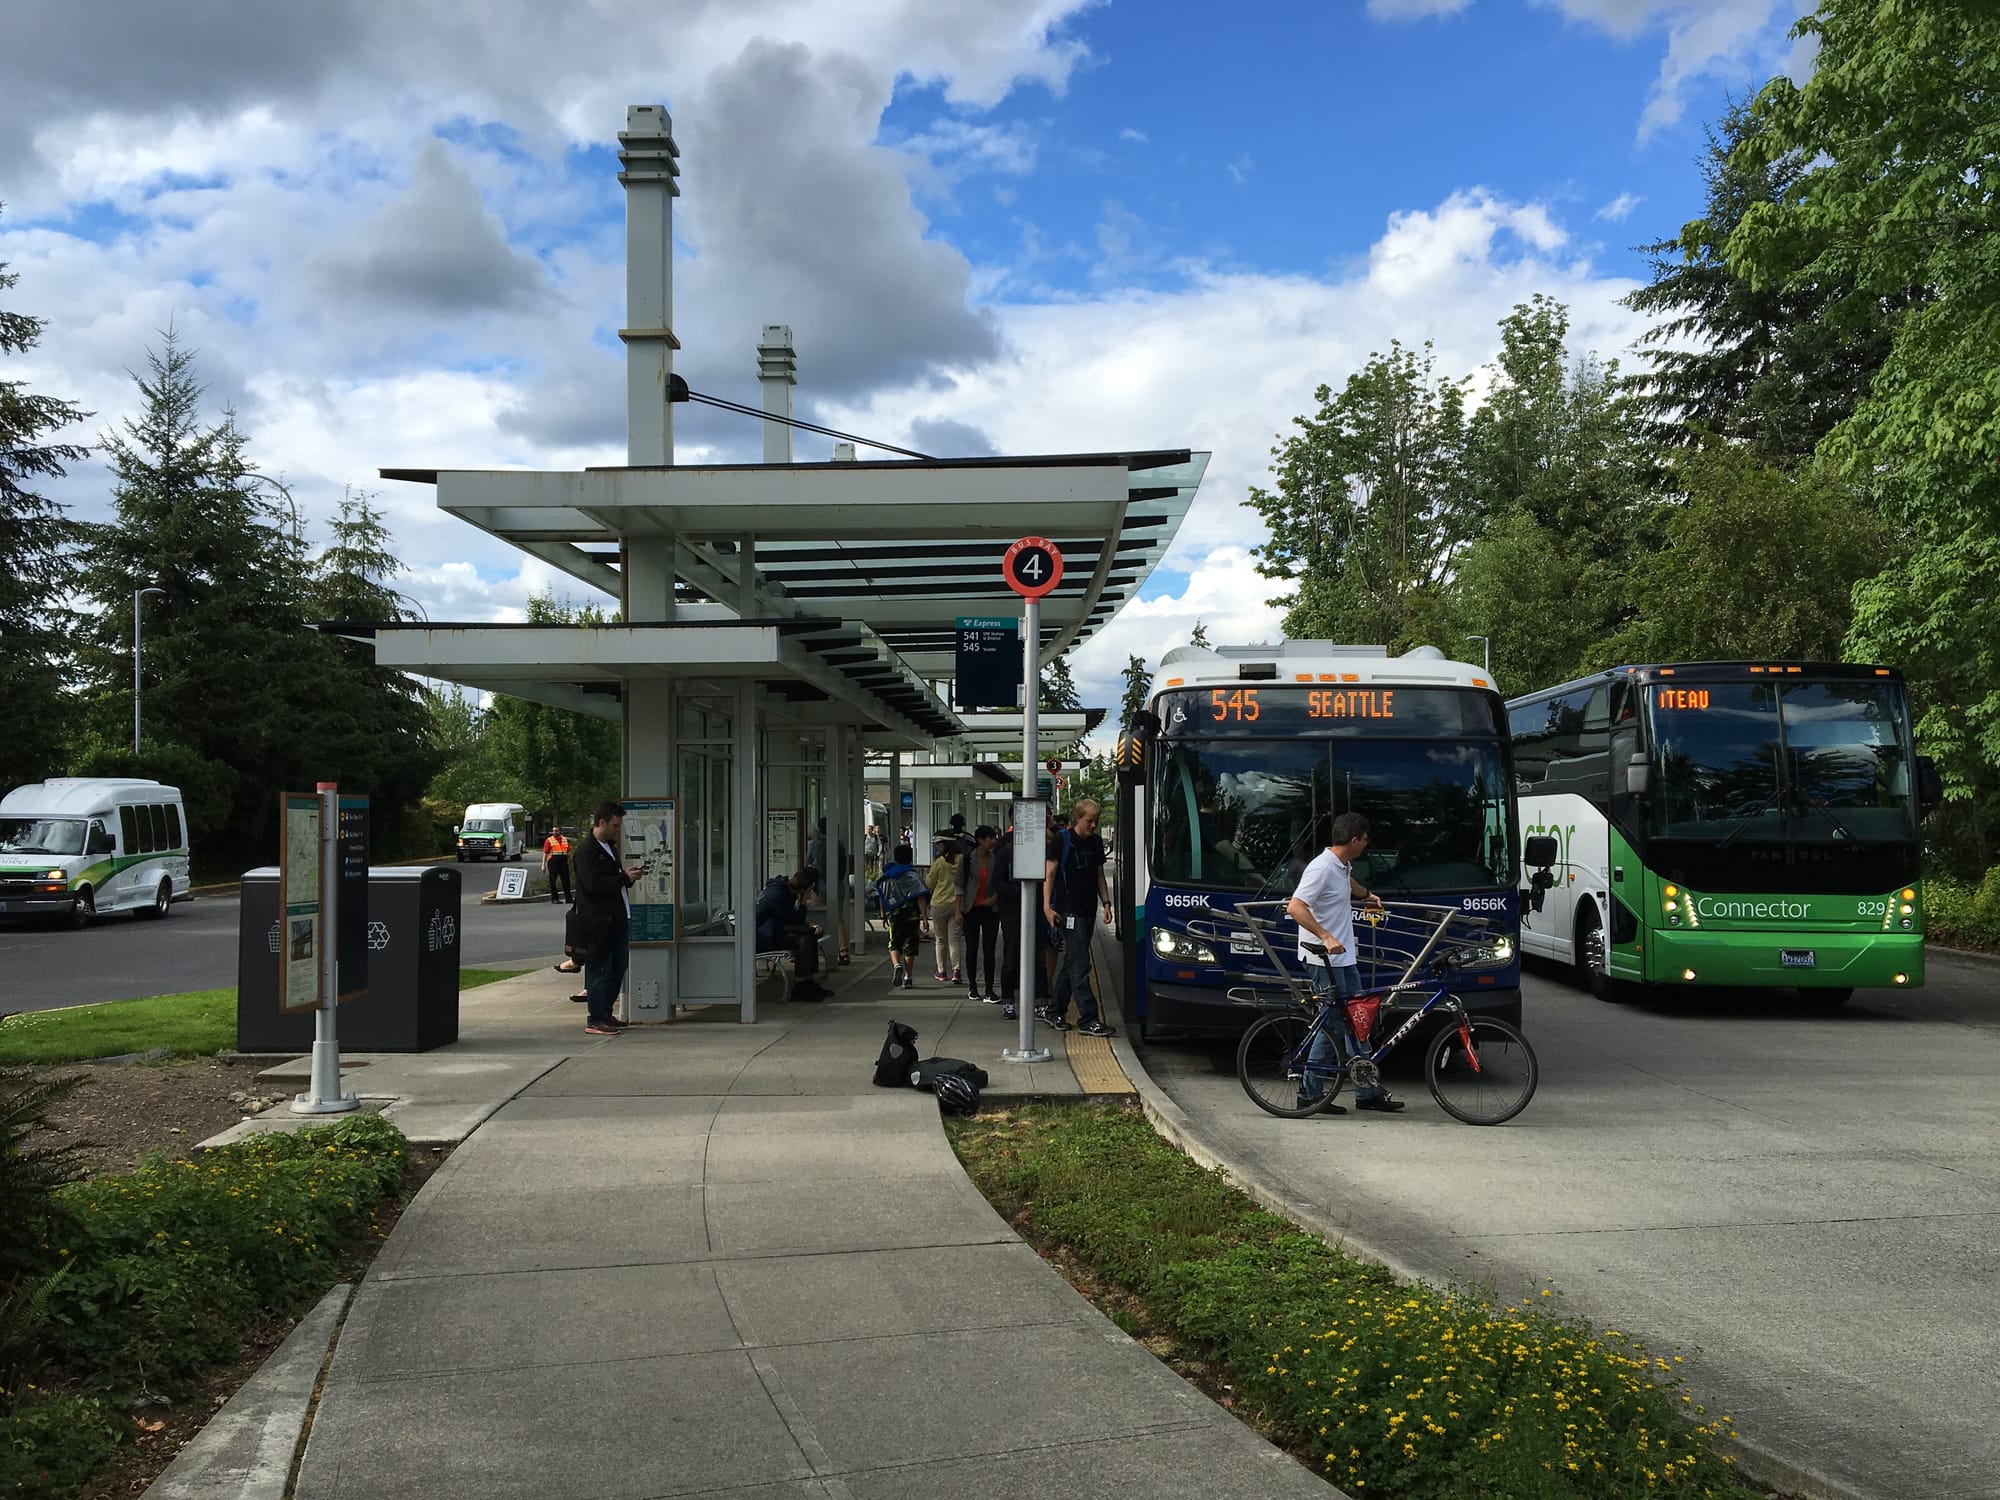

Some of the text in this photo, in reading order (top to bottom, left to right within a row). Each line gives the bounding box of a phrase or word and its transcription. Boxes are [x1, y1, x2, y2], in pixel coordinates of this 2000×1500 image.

[1011, 539, 1057, 554] BUS BAY
[1022, 554, 1043, 580] 4
[974, 619, 1001, 628] Express
[963, 631, 979, 640] 541
[963, 642, 980, 652] 545
[1211, 689, 1394, 721] 545 SEATTLE
[1051, 761, 1057, 769] 3
[507, 883, 516, 893] 5
[1165, 894, 1210, 908] 9656K
[1463, 898, 1508, 911] 9656K
[1698, 897, 1812, 918] Connector
[1857, 902, 1885, 916] 829
[1387, 1009, 1428, 1046] TREK
